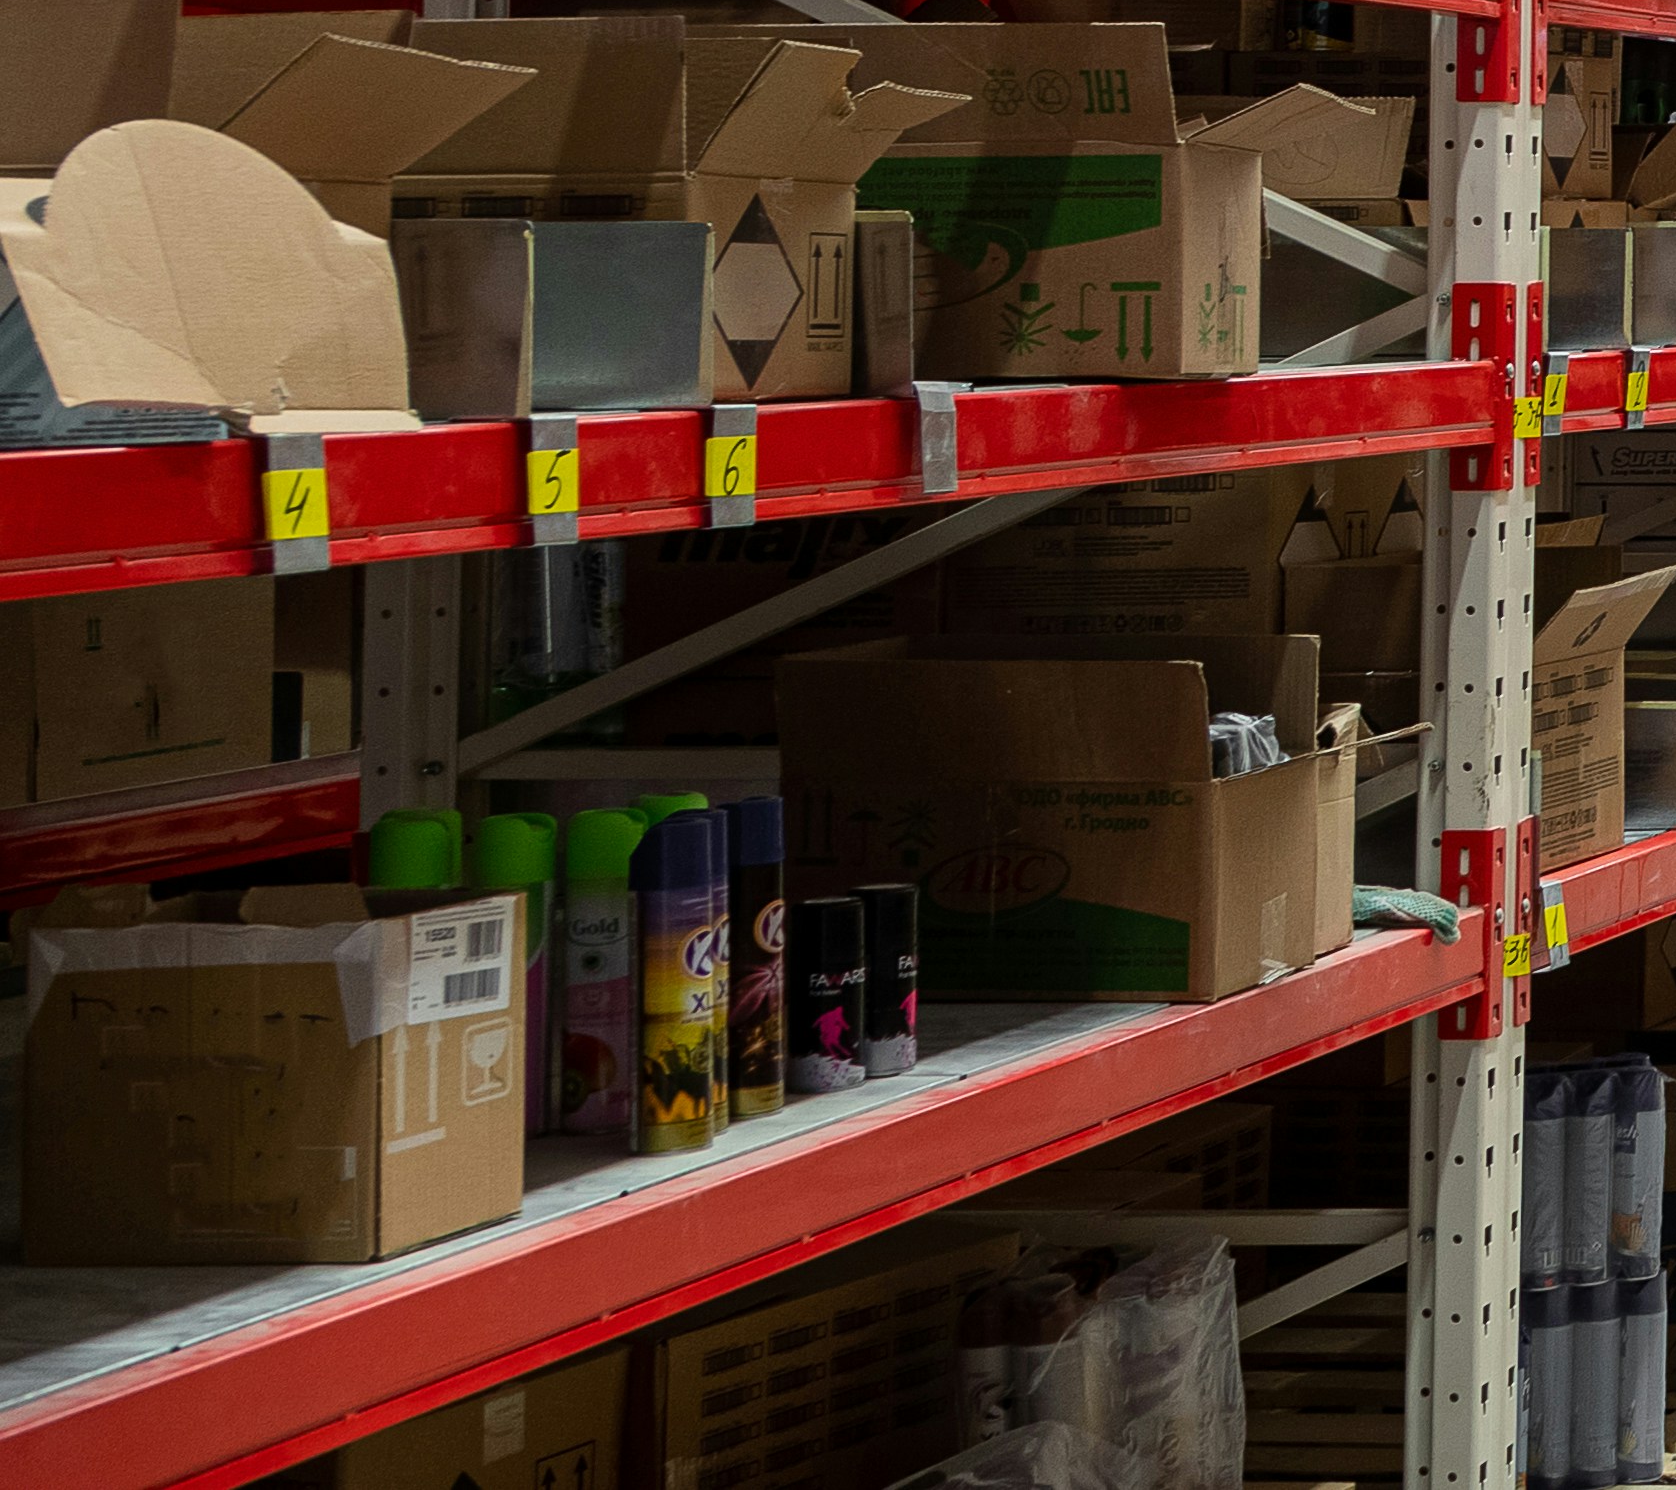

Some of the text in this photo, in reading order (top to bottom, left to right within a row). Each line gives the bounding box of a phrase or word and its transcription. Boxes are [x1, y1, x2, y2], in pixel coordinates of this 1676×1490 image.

[1633, 364, 1644, 408] 2
[544, 451, 571, 510] 5
[723, 437, 747, 497] 6
[284, 471, 310, 534] 4
[1018, 787, 1060, 808] ОДО
[1077, 814, 1149, 832] Гродно
[570, 916, 621, 937] Gold
